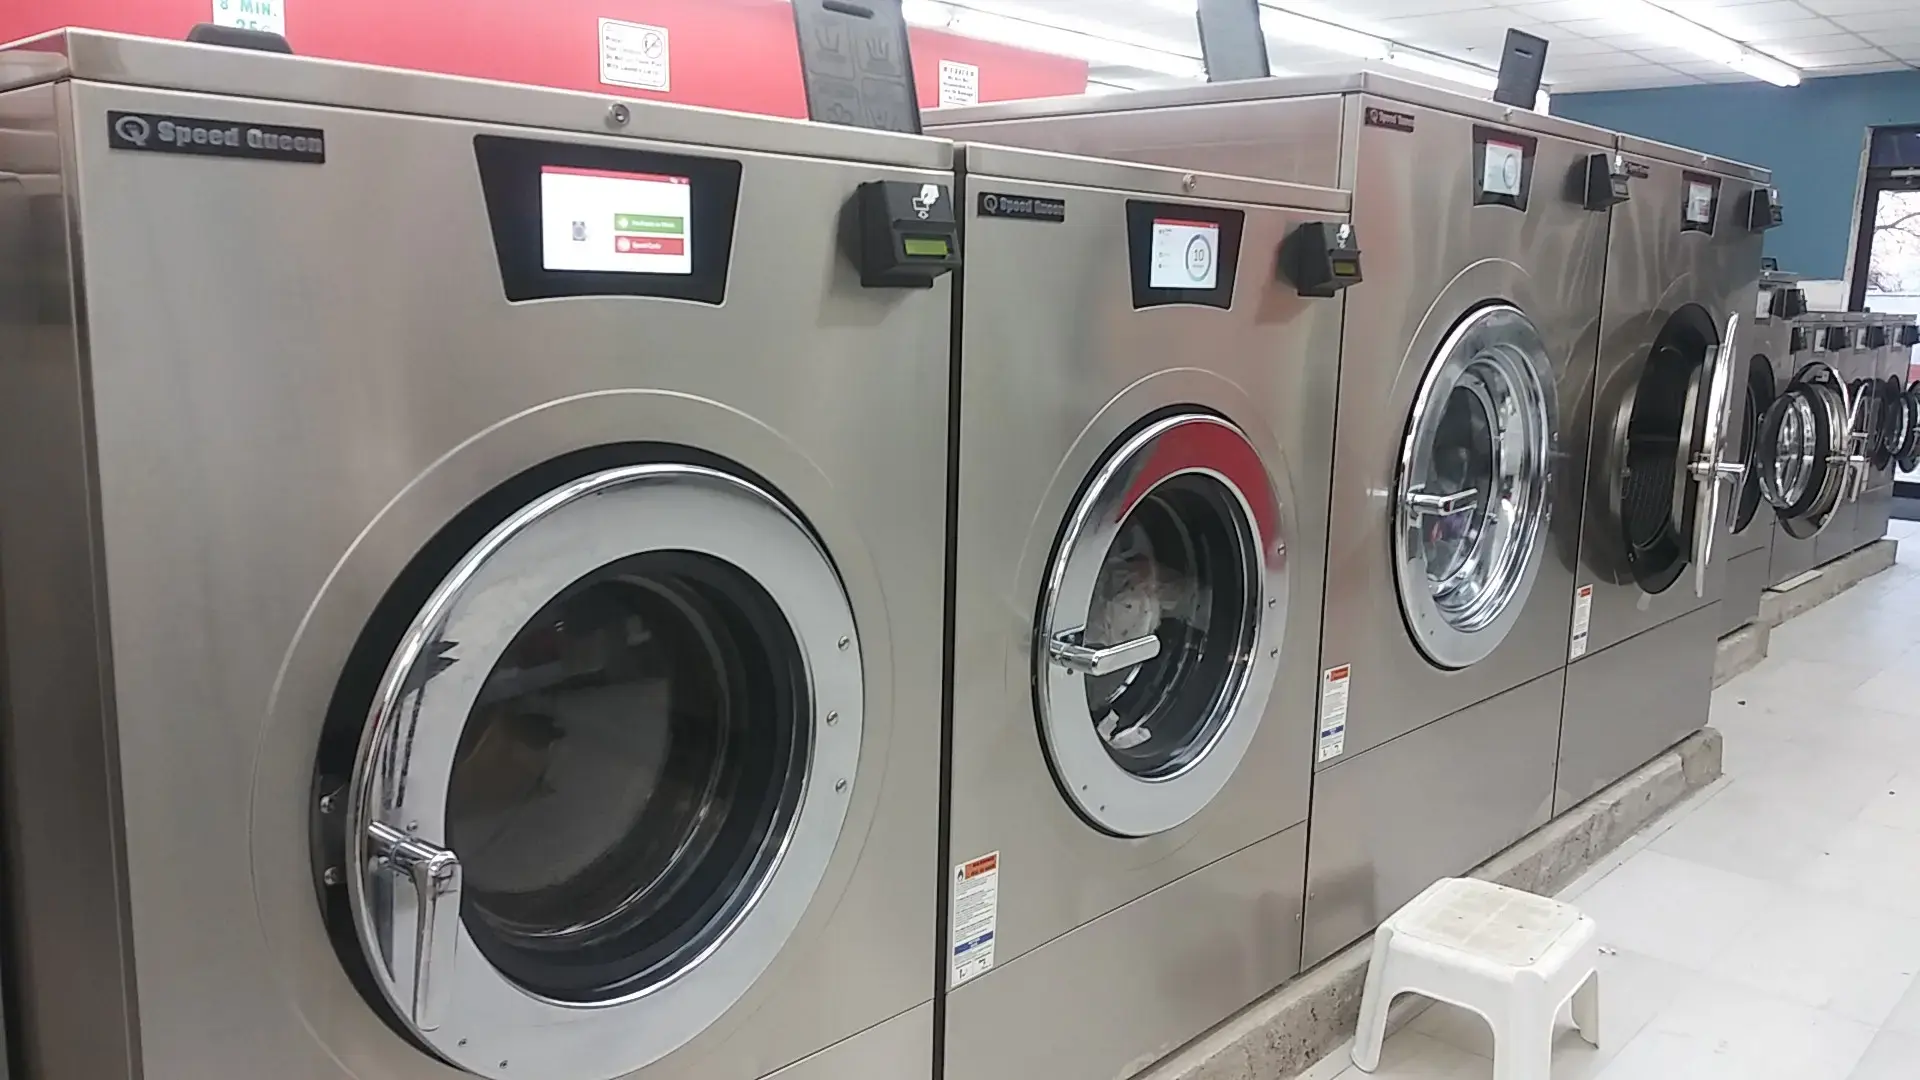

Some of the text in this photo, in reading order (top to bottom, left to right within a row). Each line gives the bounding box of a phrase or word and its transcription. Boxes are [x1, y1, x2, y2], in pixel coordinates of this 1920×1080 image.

[157, 120, 240, 147] Speed
[246, 129, 323, 153] Queen
[1194, 249, 1204, 262] 10
